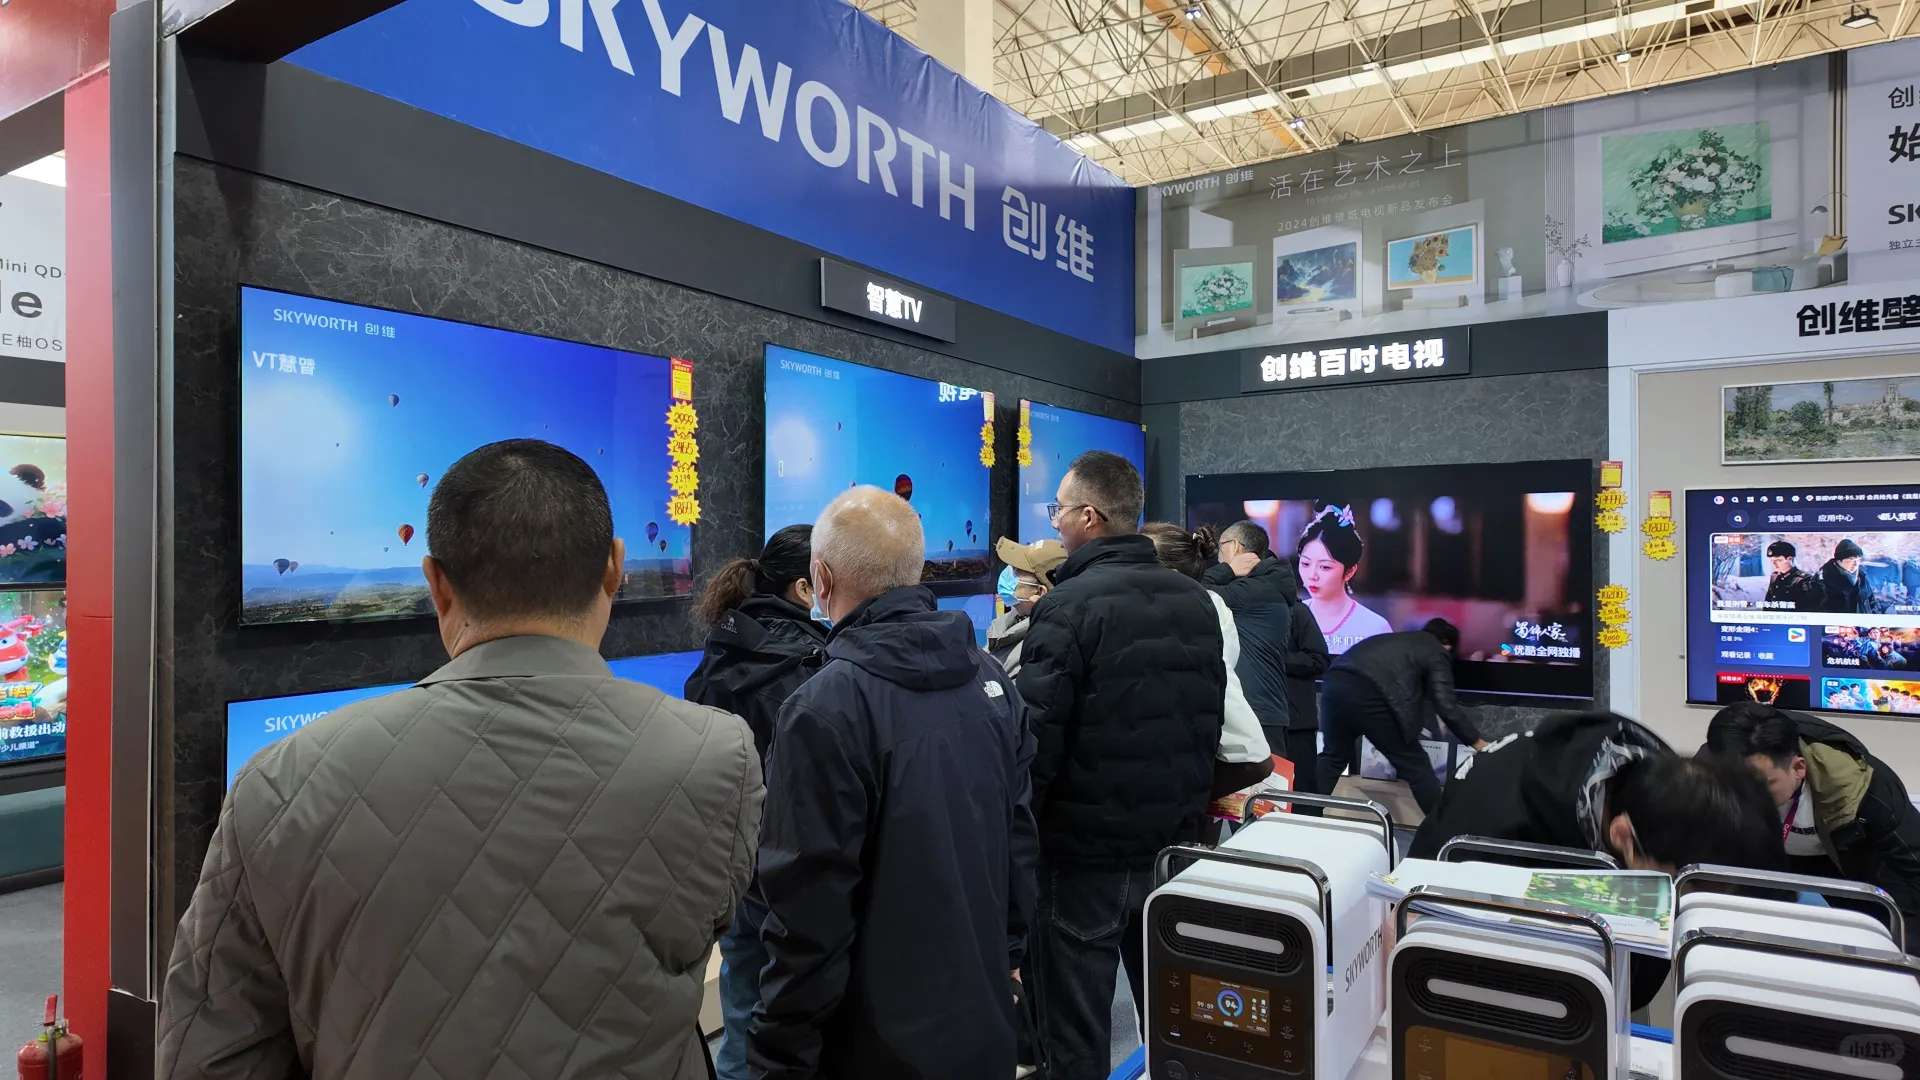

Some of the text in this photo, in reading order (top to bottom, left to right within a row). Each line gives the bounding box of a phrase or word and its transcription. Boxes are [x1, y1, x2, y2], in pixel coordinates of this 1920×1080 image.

[1888, 84, 1920, 109] 创
[1151, 169, 1254, 199] SKYWORTH 创维
[1269, 143, 1461, 199] 活在艺术之上
[1278, 194, 1454, 231] 2024创维壁纸电视新品发布会
[1001, 185, 1095, 282] 创维
[0, 279, 42, 319] e
[866, 281, 922, 323] 智慧TV
[273, 308, 396, 338] SKYWORTH 创维
[2, 333, 63, 351] E柚OS
[780, 359, 822, 377] SKYWORTH
[1260, 338, 1445, 382] 创维百吋电视
[1768, 514, 1803, 523] 宽带电视
[1818, 514, 1854, 522] 应用中心
[1513, 644, 1581, 659] 优酷全网独播
[1721, 651, 1774, 660] 观看记录 收藏
[1827, 657, 1860, 666] 危机航线
[1345, 924, 1383, 993] SKYWORTH
